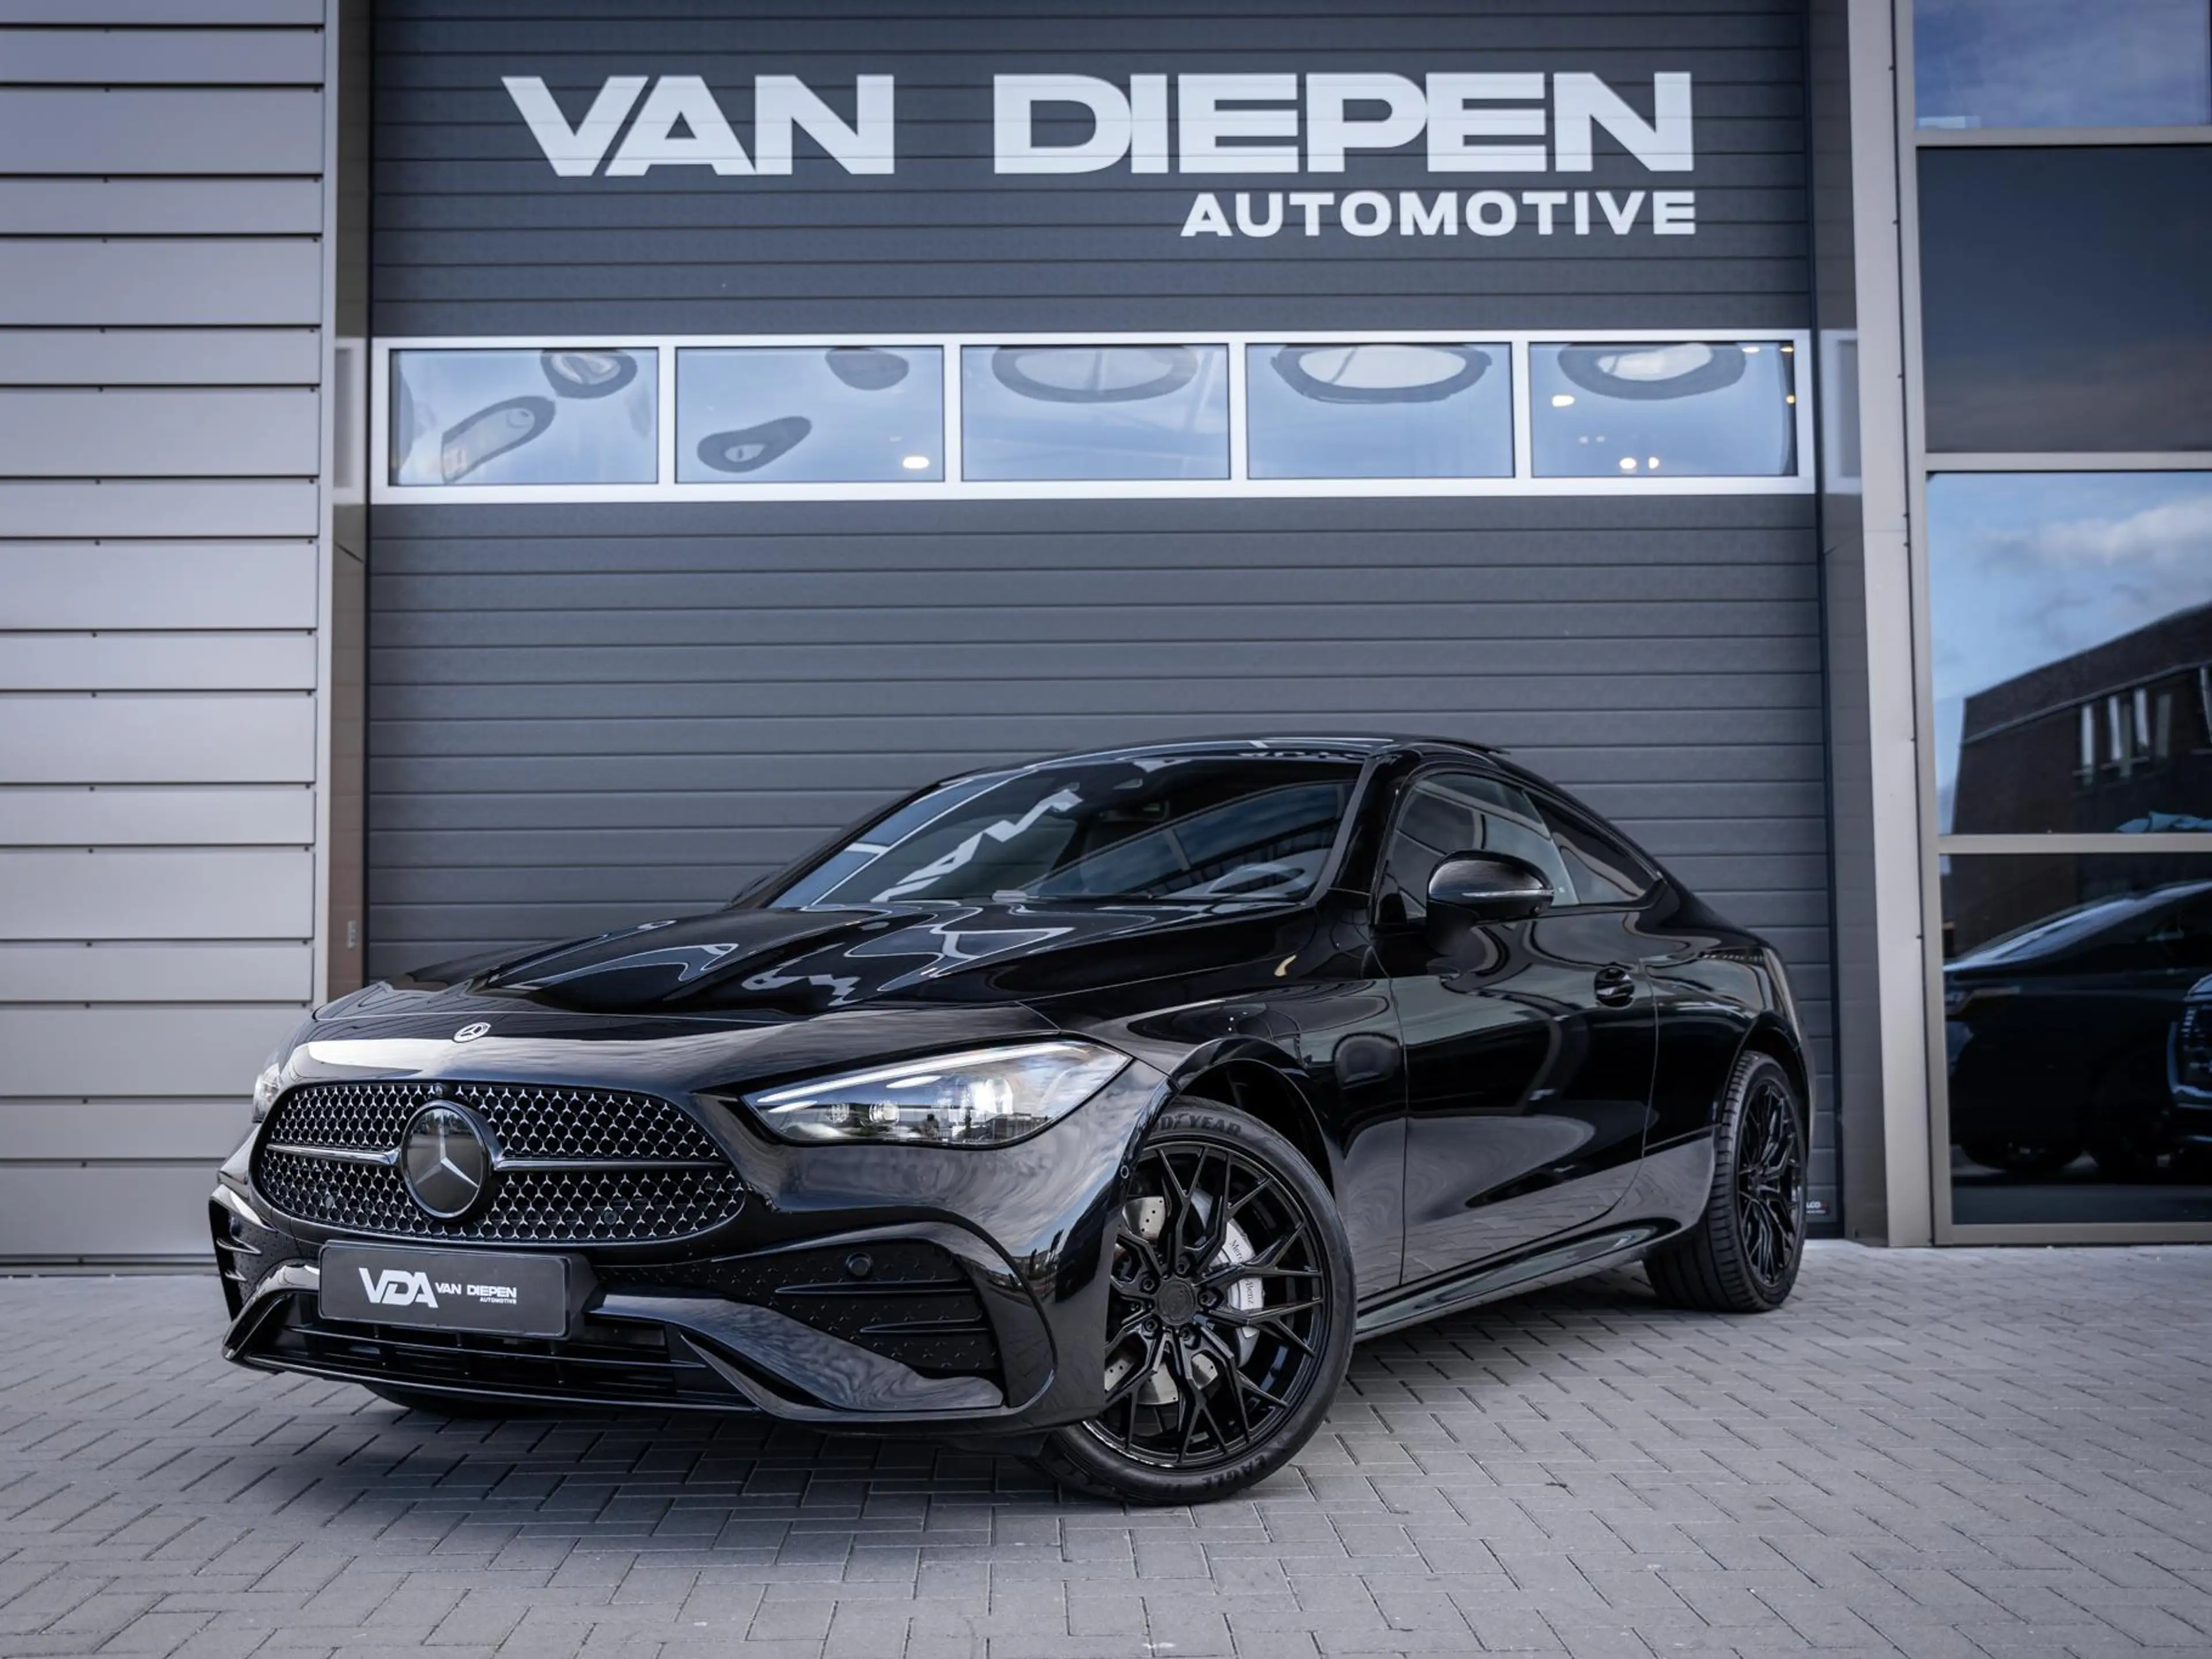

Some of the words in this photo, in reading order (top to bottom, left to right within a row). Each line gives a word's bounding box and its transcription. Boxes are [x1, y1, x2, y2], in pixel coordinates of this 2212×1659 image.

[502, 75, 895, 176] VAN
[994, 72, 1694, 174] DIEPEN
[1180, 191, 1696, 237] AUTOMOTIVE
[358, 1267, 438, 1308] VDA
[434, 1282, 462, 1295] VAN
[467, 1284, 517, 1298] DIEPEN
[479, 1297, 517, 1305] AUTOMOTIVE
